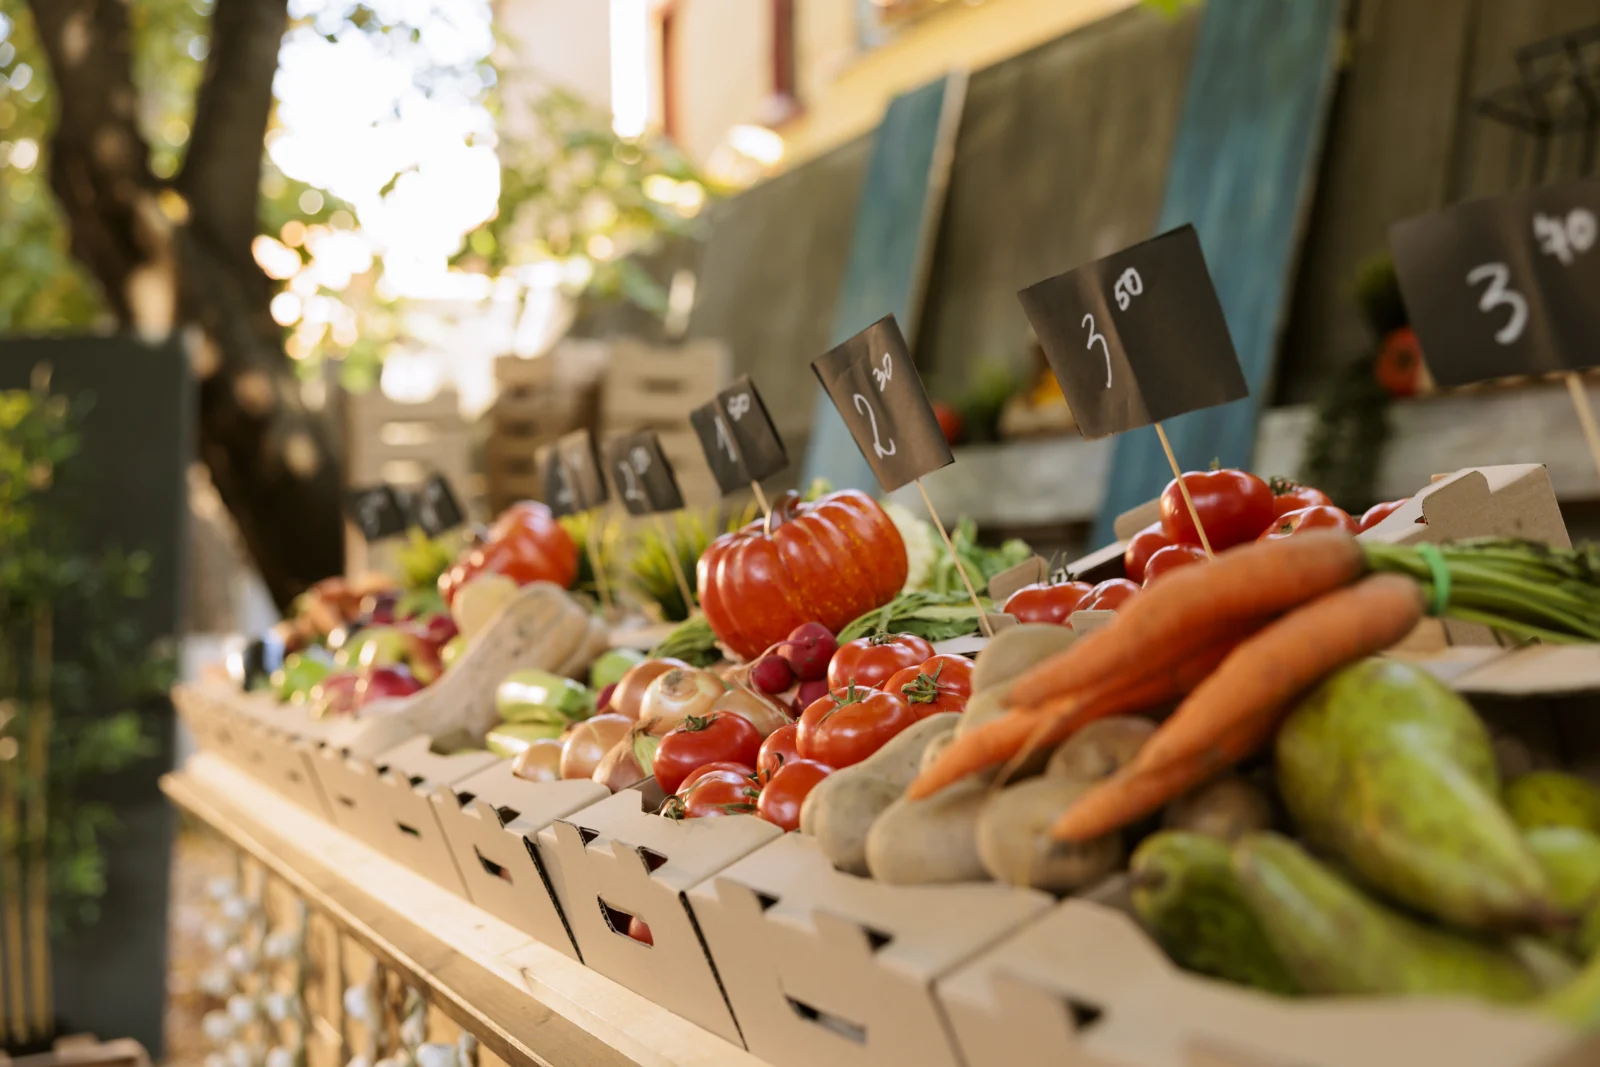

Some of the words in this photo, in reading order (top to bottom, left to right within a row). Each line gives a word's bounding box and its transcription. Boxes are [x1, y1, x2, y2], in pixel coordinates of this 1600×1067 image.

[1081, 313, 1113, 389] 3
[1114, 267, 1144, 312] 50
[1466, 262, 1528, 345] 3
[853, 393, 896, 459] 2
